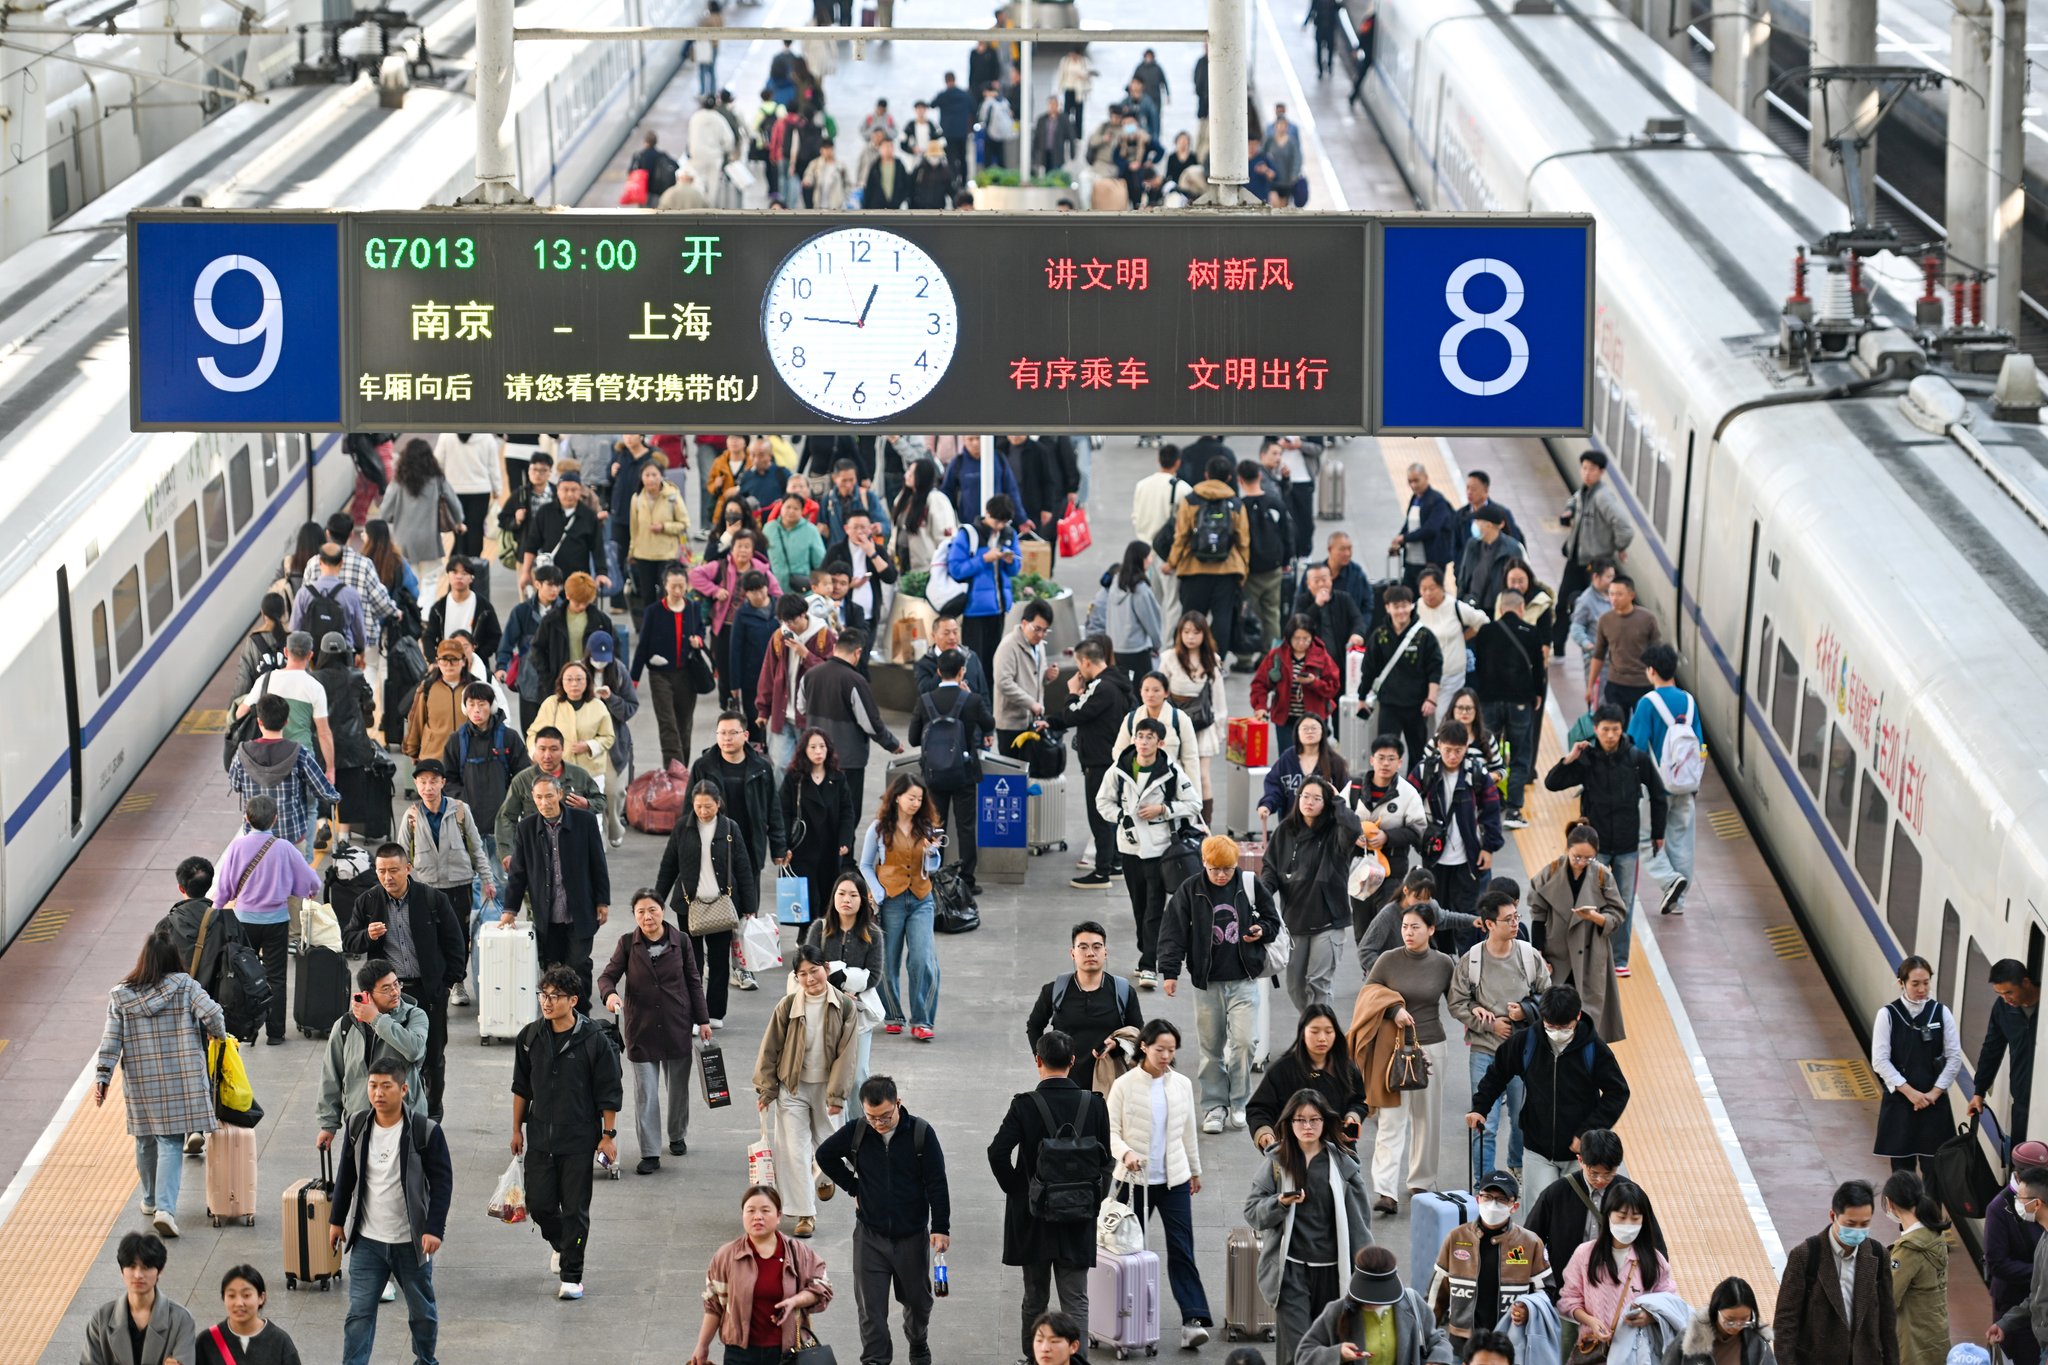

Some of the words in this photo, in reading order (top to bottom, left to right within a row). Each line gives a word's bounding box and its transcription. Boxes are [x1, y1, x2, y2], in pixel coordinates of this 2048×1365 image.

[365, 238, 476, 270] G7013
[535, 239, 637, 271] 13:00
[682, 237, 723, 276] 开
[817, 252, 832, 274] 11
[849, 240, 872, 263] 12
[893, 250, 900, 273] 1
[1045, 257, 1149, 292] 讲文明
[1187, 257, 1295, 292] 树新风
[791, 277, 812, 300] 10
[914, 275, 929, 299] 2
[194, 255, 284, 394] 9
[412, 300, 495, 342] 南京
[629, 302, 713, 343] 上海
[779, 311, 793, 333] 9
[926, 312, 941, 336] 3
[1440, 258, 1531, 397] 8
[791, 345, 806, 369] 8
[913, 349, 929, 372] 4
[822, 371, 837, 394] 7
[888, 373, 902, 397] 5
[1010, 357, 1150, 391] 有序乘车
[1188, 357, 1330, 391] 文明出行
[360, 373, 473, 402] 车厢向后
[852, 381, 867, 405] 6
